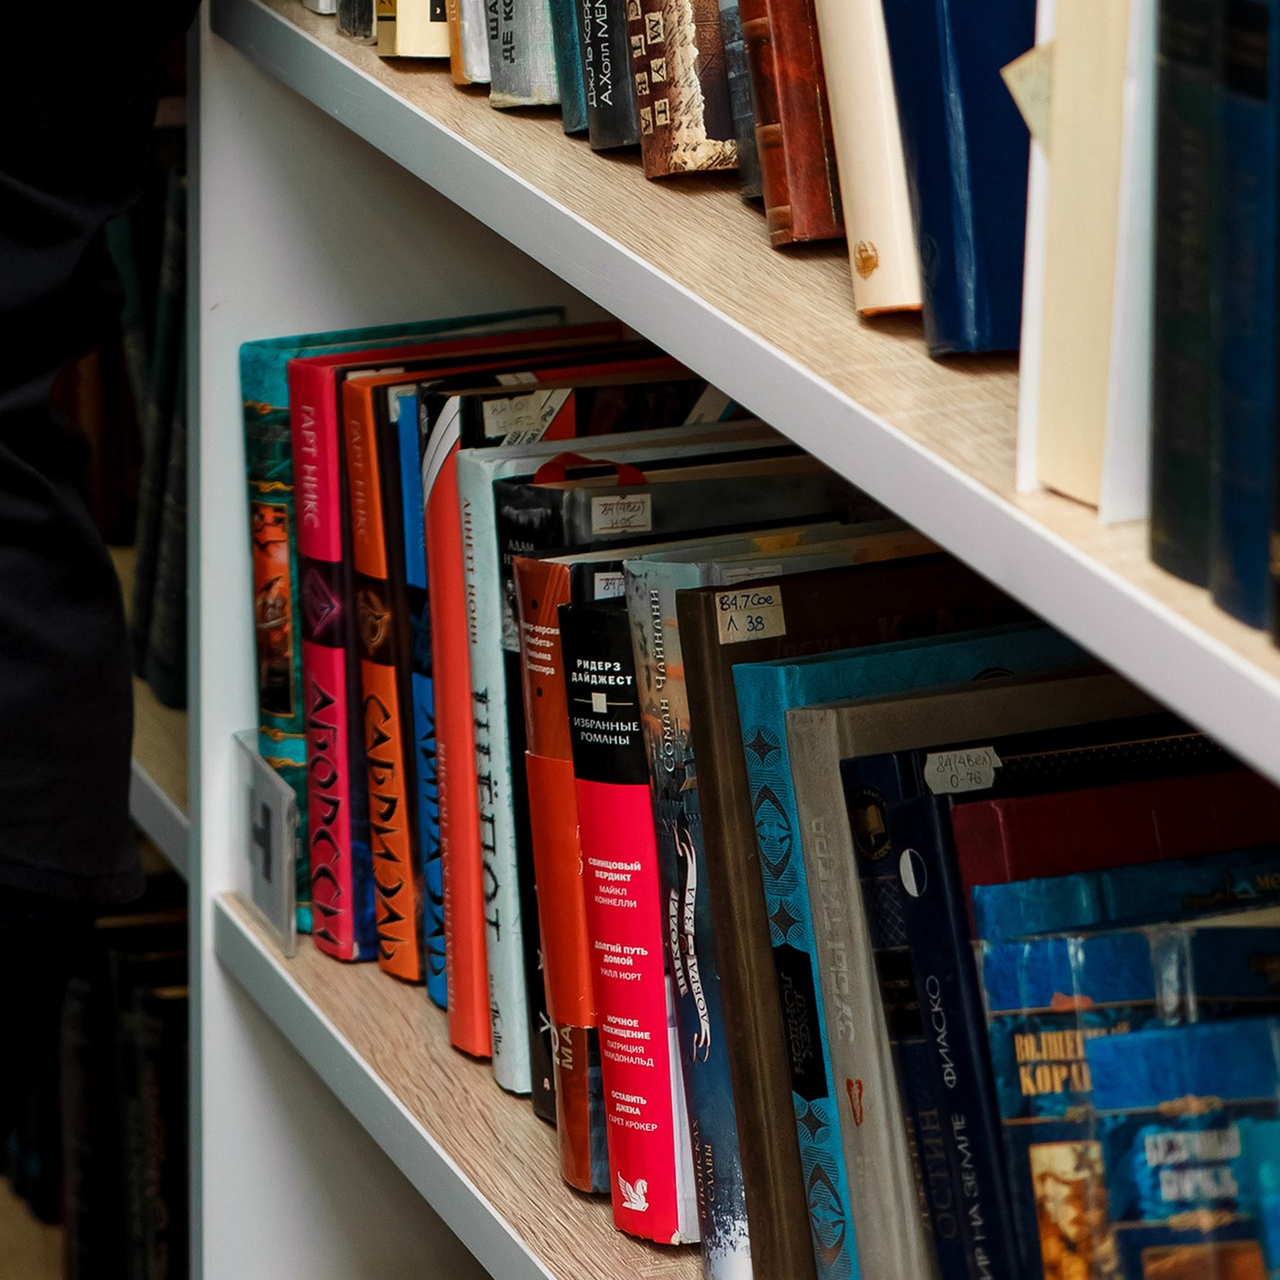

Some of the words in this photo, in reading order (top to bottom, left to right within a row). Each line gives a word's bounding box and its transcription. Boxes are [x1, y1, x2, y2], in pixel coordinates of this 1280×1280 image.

[502, 25, 516, 64] ДЕ
[599, 42, 614, 106] А.Холл
[300, 405, 318, 457] ГАРТ
[303, 464, 320, 528] НИКС
[746, 616, 765, 631] 38
[649, 589, 667, 689] ЧАЙНАНИ
[576, 659, 621, 672] РИДЕРЗ
[571, 671, 633, 685] ДАЙДЖЕСТ
[574, 717, 639, 732] ИЗБРАННЫЕ
[581, 731, 630, 745] РОМАНЫ
[660, 698, 675, 772] СОМАН
[588, 857, 641, 871] СВИНЦОВЫЙ
[595, 870, 631, 882] ВЕРДИКТ
[599, 884, 627, 896] МАЙКЛ
[594, 895, 637, 908] КОННЕЛЛИ
[684, 887, 696, 931] ЗЛА
[623, 944, 648, 956] ПУТЬ
[603, 954, 633, 967] ДОМОЙ
[619, 970, 641, 981] НОРТ
[688, 962, 710, 1025] ДОБРА
[607, 1014, 639, 1028] НОЧНОЕ
[781, 972, 805, 1074] ЛОНДОН
[602, 1025, 651, 1040] ПОХИЩЕНИЕ
[925, 975, 957, 1088] ФИАСКО
[607, 1039, 645, 1054] ПАТРИЦИЯ
[603, 1049, 654, 1067] МАКДОНАЛЬД
[611, 1090, 647, 1105] ОСТАВИТЬ
[615, 1103, 641, 1116] ДЖЕКА
[625, 1120, 658, 1132] КРОКЕР
[951, 1114, 980, 1197] ЗЕМЛЕ
[704, 1144, 716, 1203] СЛАВЫ
